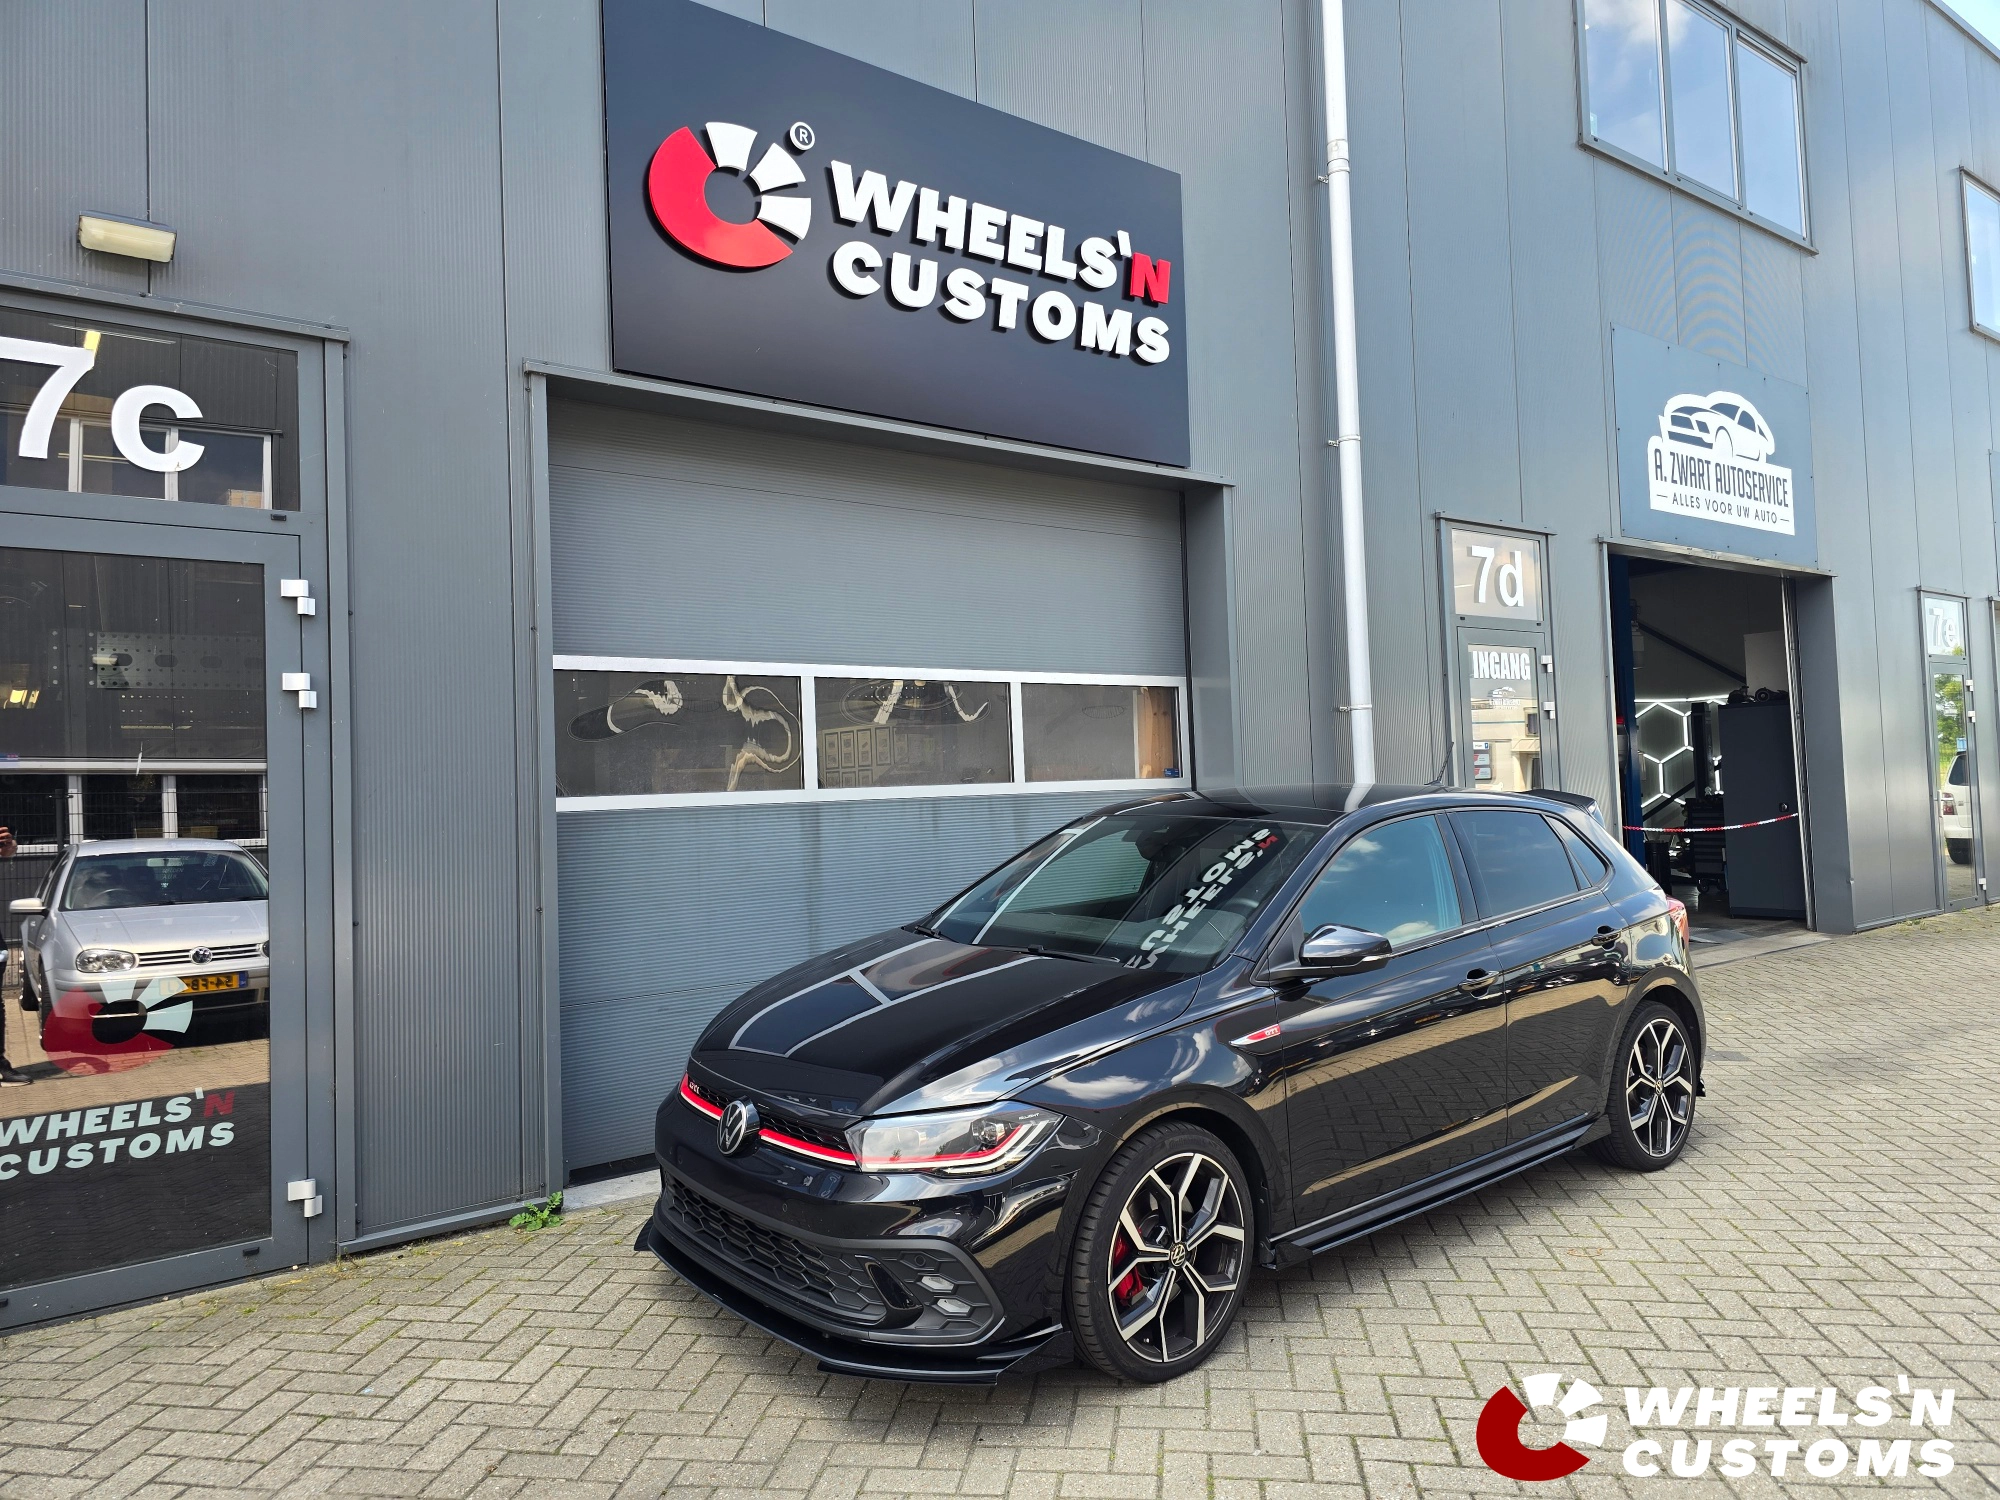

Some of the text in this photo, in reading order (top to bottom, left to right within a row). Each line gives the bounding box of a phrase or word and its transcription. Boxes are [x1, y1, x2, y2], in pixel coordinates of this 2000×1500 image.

[831, 160, 1171, 304] WHEELS'N
[833, 241, 1170, 363] CUSTOMS
[0, 336, 205, 472] 7c
[1654, 448, 1789, 508] A. ZWART AUTOSERVICE
[1672, 492, 1778, 524] ALLES VOOR UW AUTO
[1471, 545, 1524, 607] 7d
[1472, 650, 1531, 680] INGANG
[1264, 1027, 1279, 1037] GTI
[0, 1121, 235, 1181] CUSTOMS
